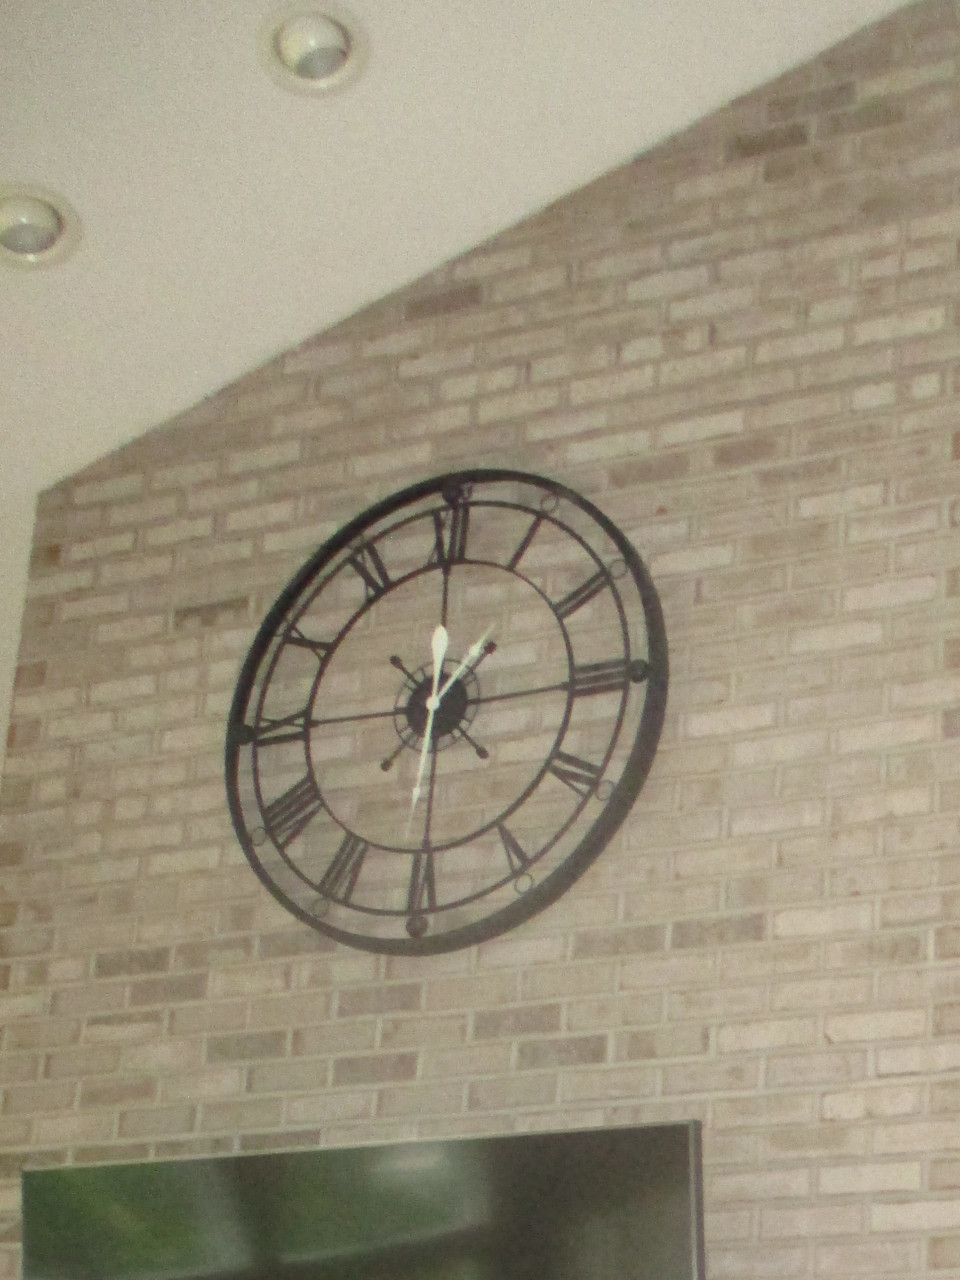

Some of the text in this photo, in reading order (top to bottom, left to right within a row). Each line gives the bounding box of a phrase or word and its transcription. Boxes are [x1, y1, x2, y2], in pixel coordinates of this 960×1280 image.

[427, 506, 470, 563] XII
[508, 515, 543, 568] I
[349, 542, 391, 602] XI
[551, 569, 612, 619] II
[572, 658, 630, 697] III
[256, 707, 309, 747] IX
[547, 750, 604, 797] IV
[263, 773, 324, 850] VIII
[317, 834, 369, 902] VII
[498, 821, 531, 872] V
[407, 852, 436, 911] VI
